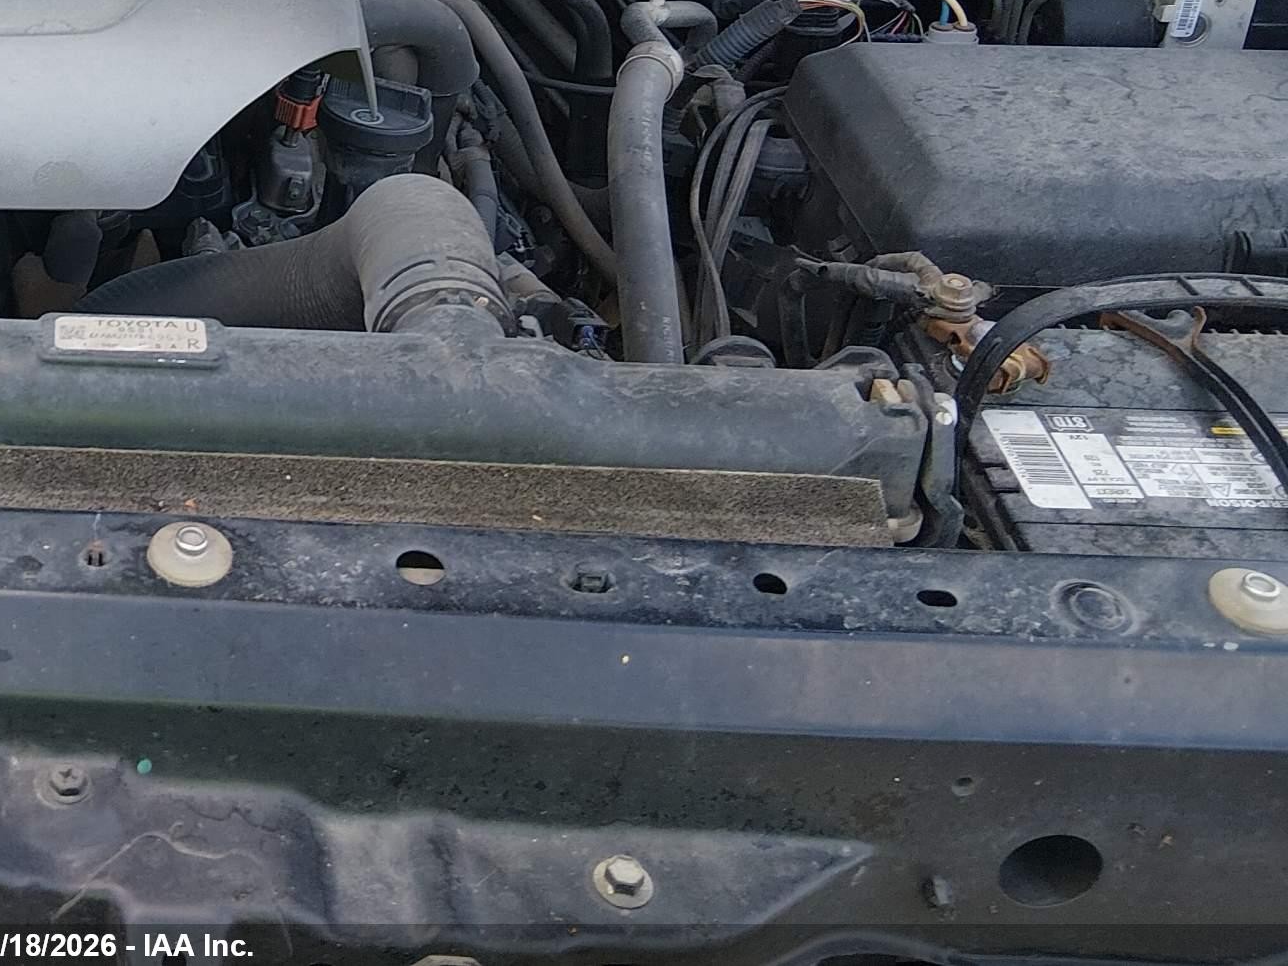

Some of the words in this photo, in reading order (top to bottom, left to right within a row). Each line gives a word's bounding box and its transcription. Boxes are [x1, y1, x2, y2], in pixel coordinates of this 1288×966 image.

[96, 319, 178, 329] TOYOTA
[185, 321, 198, 332] U
[187, 338, 201, 350] R
